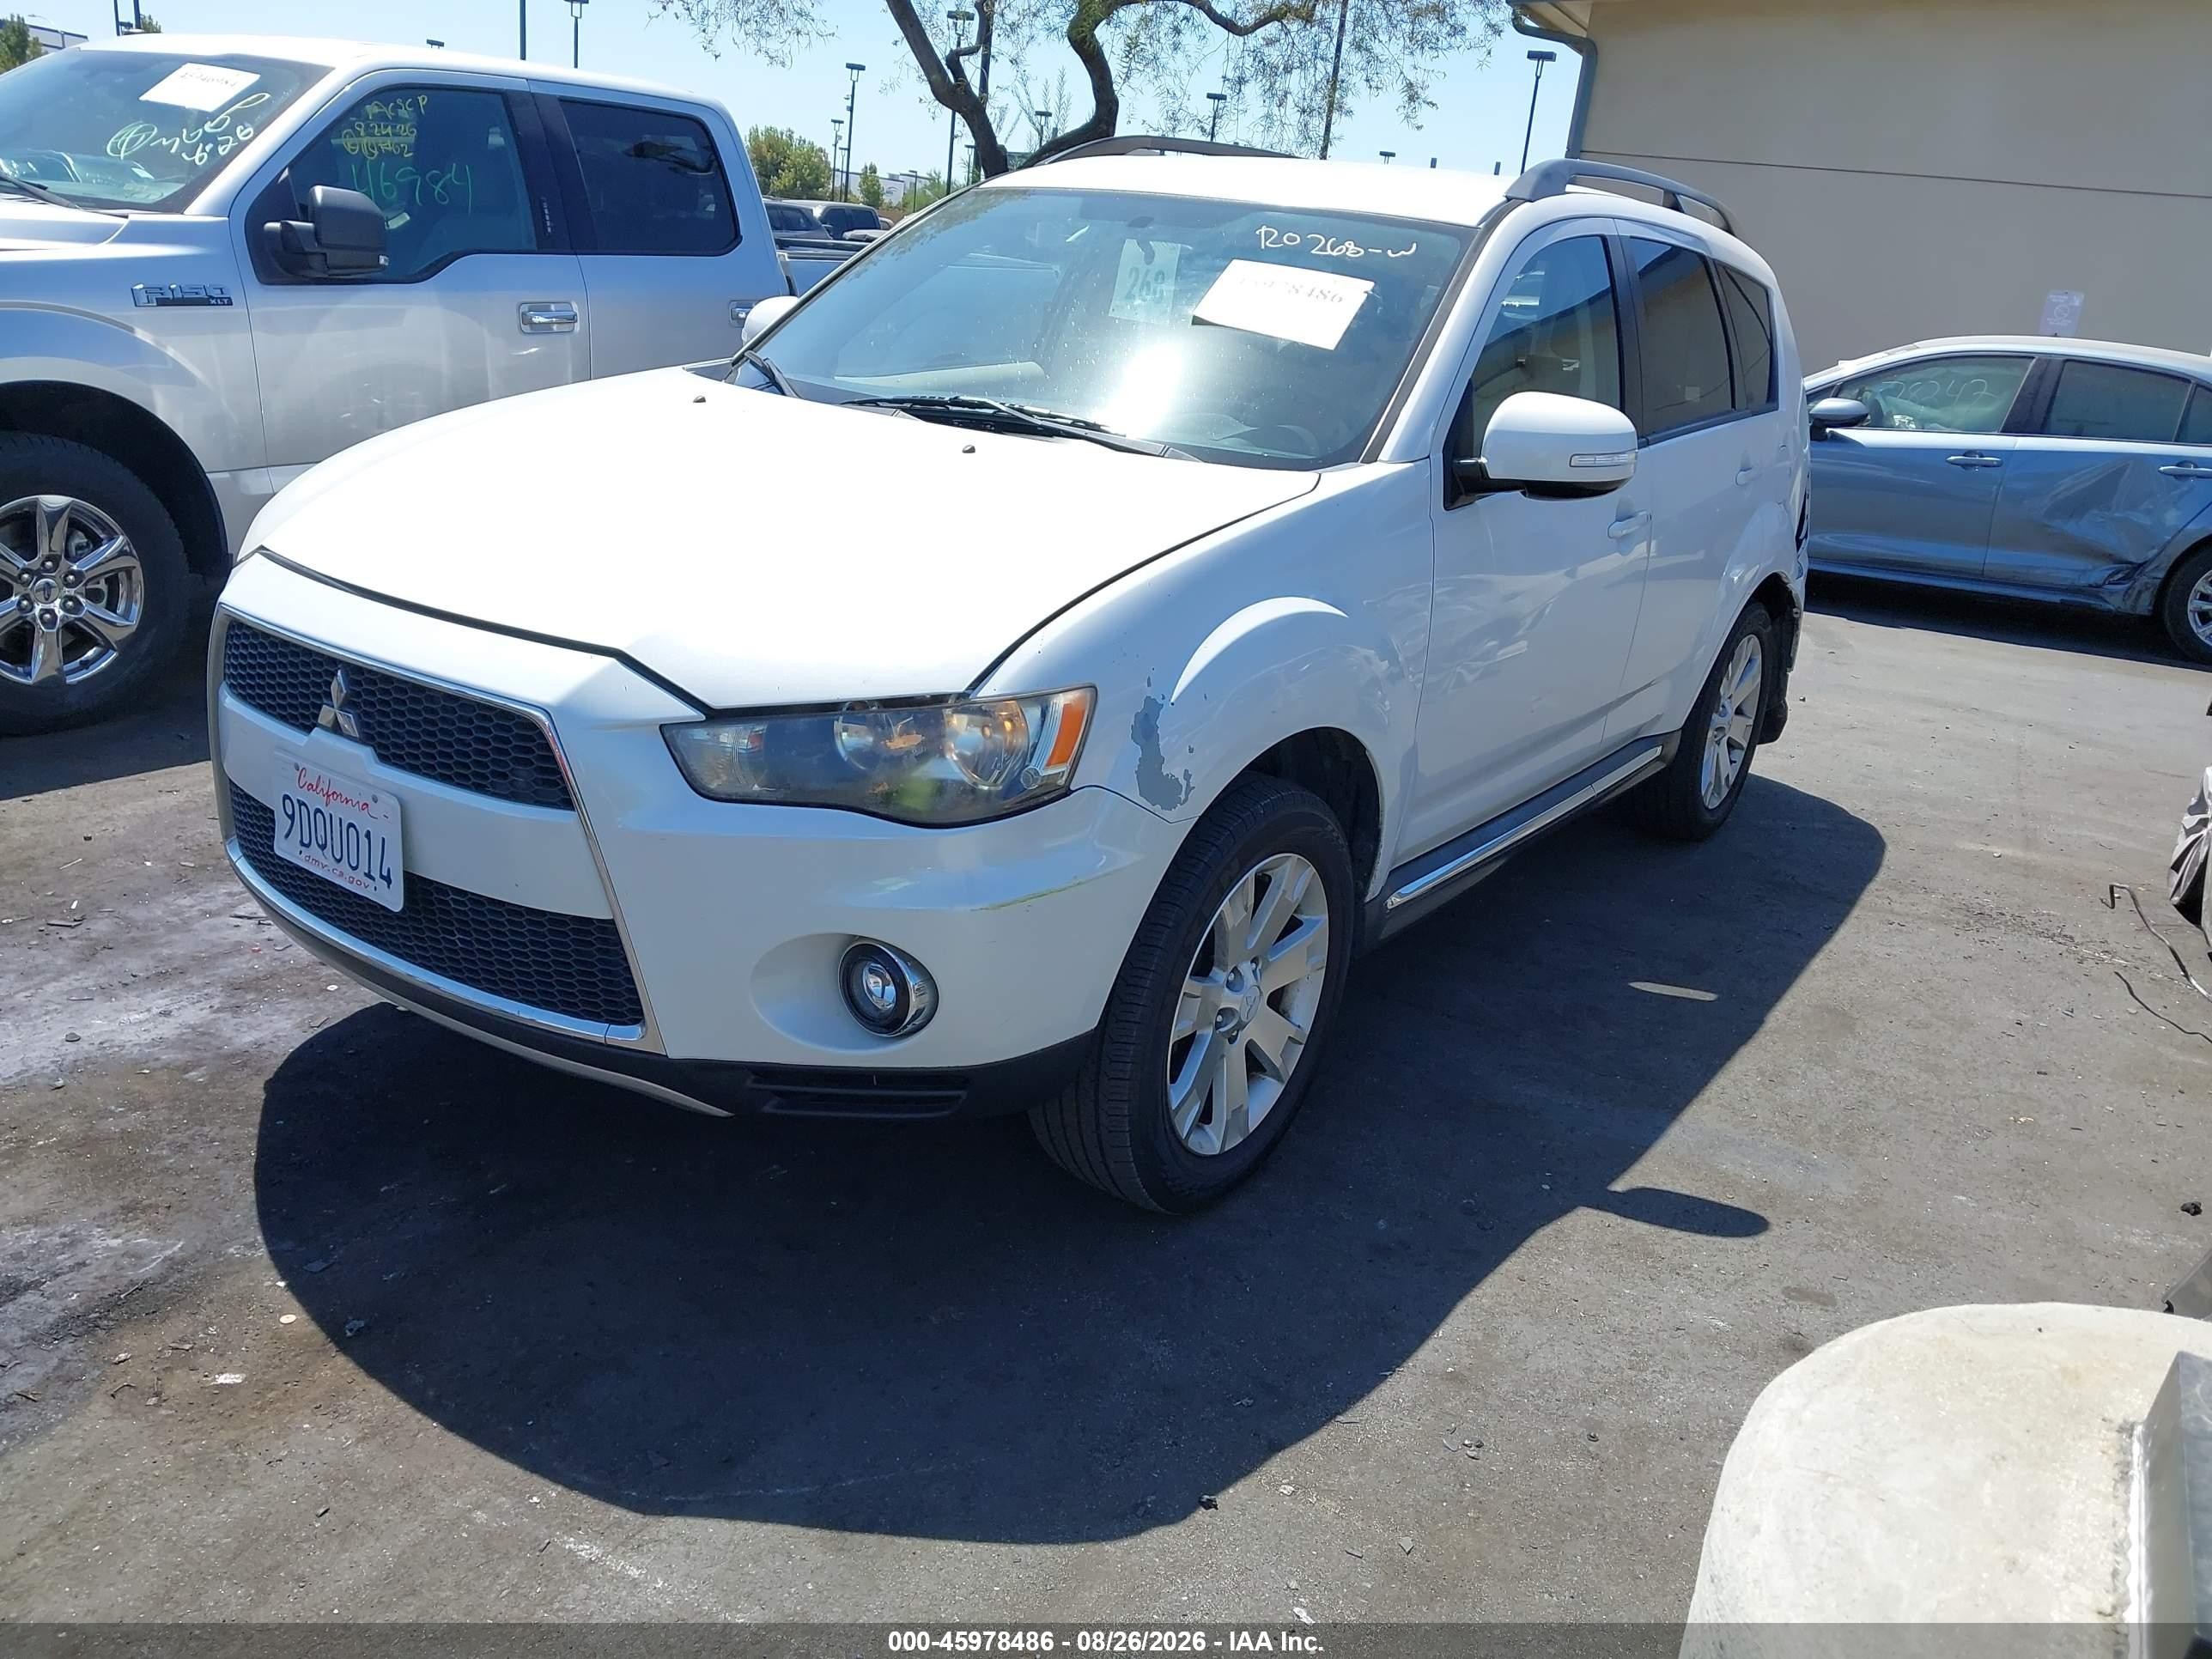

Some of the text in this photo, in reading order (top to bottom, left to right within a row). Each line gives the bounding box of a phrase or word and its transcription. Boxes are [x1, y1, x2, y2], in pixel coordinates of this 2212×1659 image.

[297, 767, 379, 820] California
[282, 793, 392, 890] 9DQU014
[304, 854, 371, 890] dmv.ca.gov
